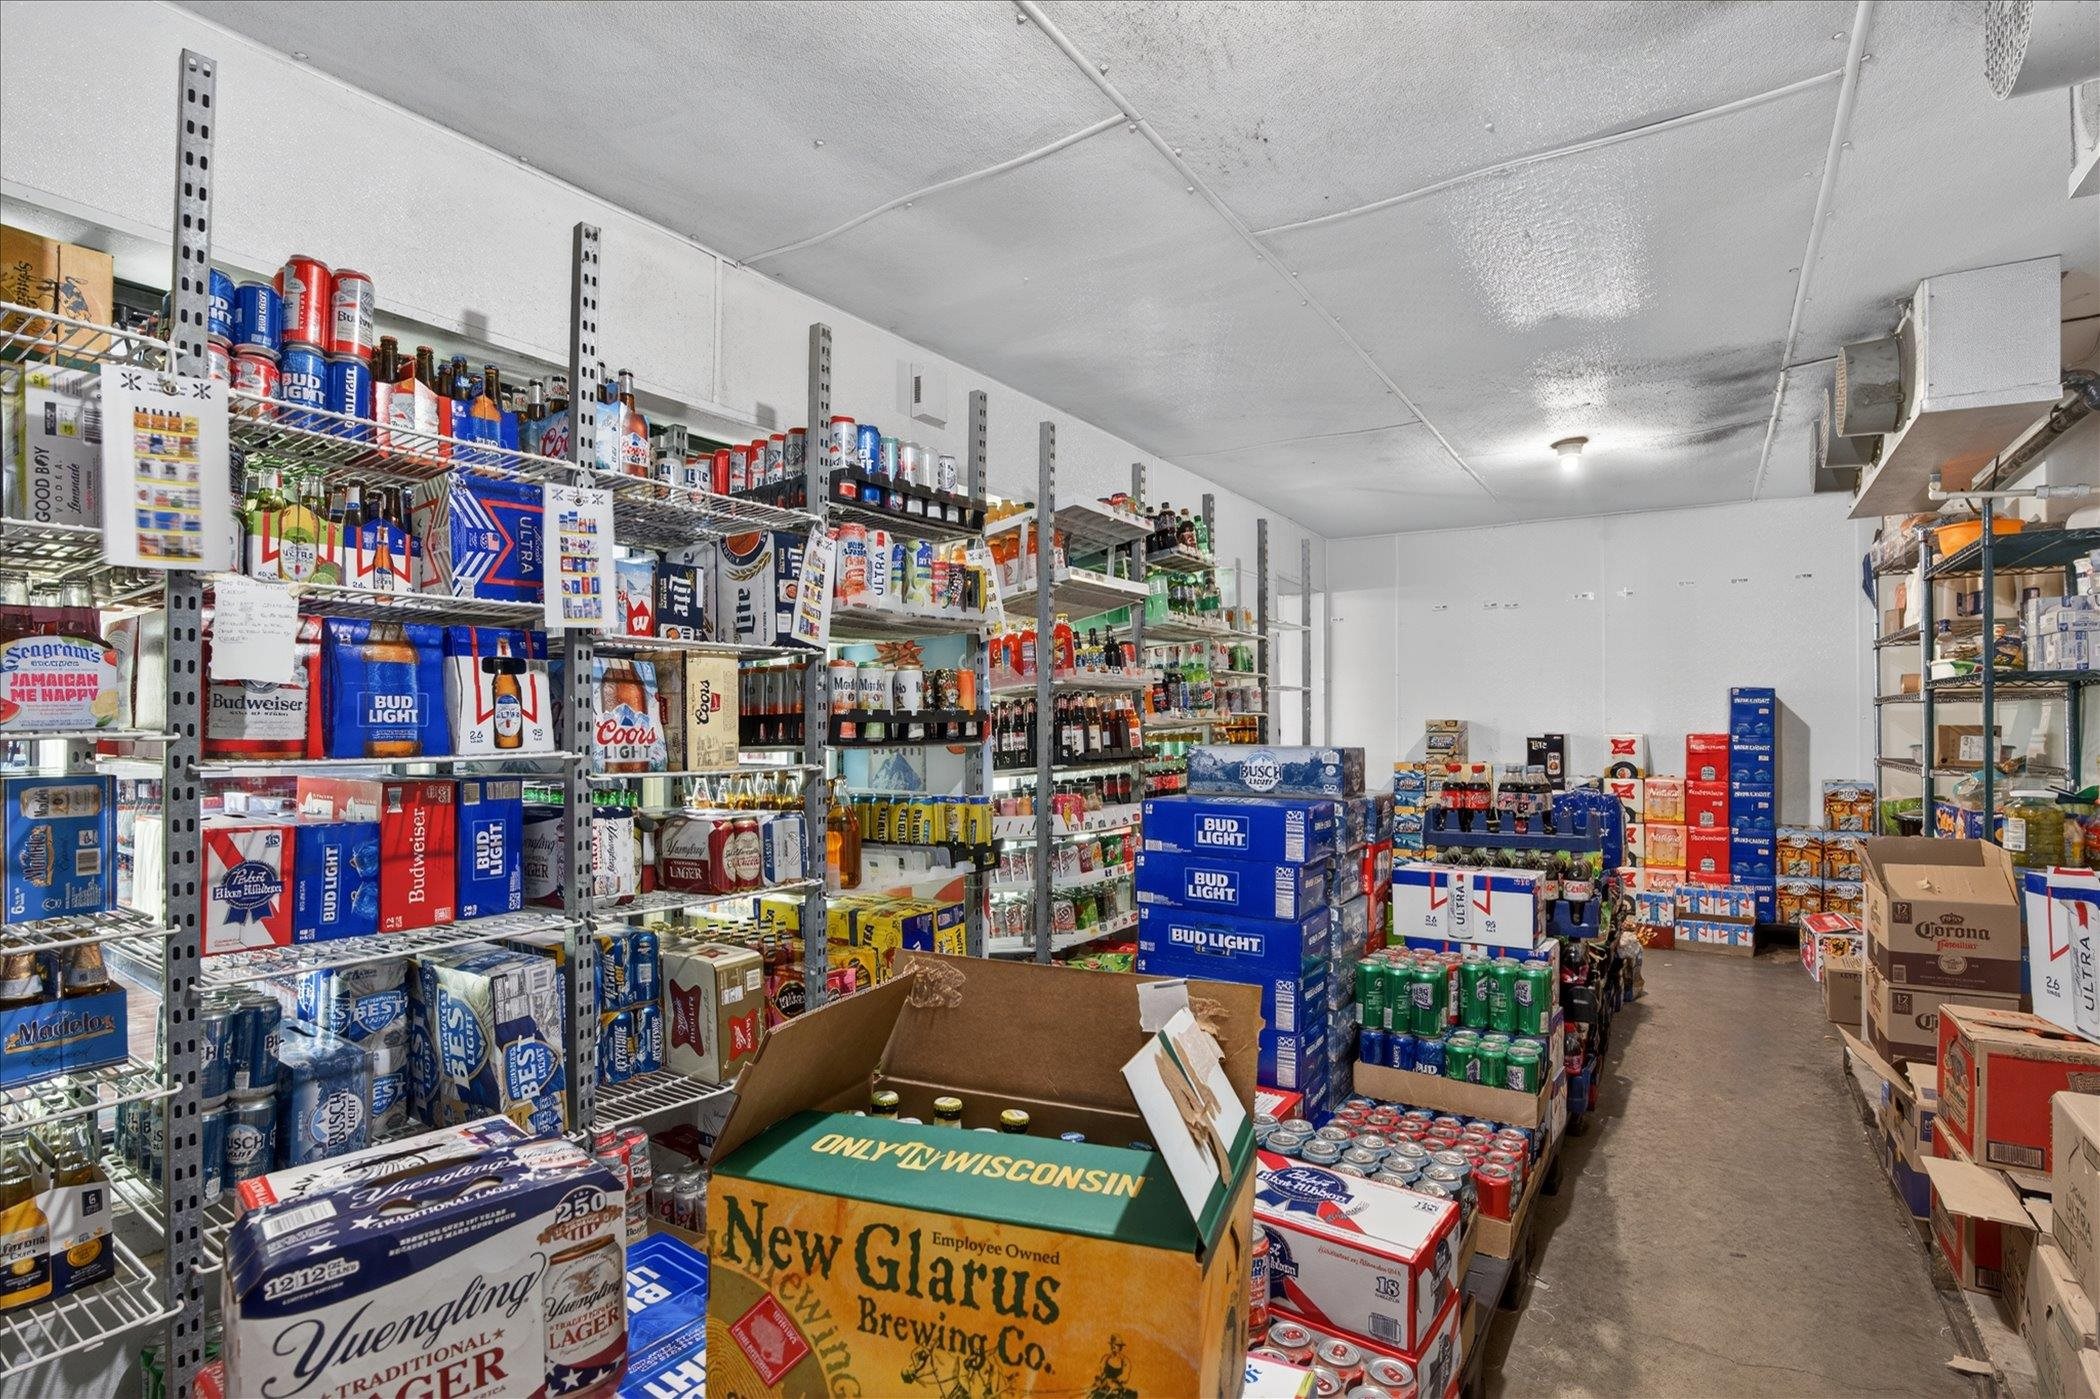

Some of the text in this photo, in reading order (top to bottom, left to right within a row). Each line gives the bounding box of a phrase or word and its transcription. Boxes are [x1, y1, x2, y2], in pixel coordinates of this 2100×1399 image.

[34, 446, 51, 523] GOOD BOY
[518, 516, 533, 575] ULTRA
[872, 550, 886, 596] ULTRA
[735, 587, 756, 634] Lite
[0, 642, 101, 674] Seagram's
[9, 673, 99, 688] JAMAICAN
[9, 688, 100, 703] ME HAPPY
[213, 693, 303, 711] Budweiser
[368, 708, 419, 724] LIGHT
[374, 695, 413, 709] BUD
[695, 679, 711, 725] Coors
[595, 719, 658, 746] Coors
[604, 745, 651, 759] LIGHT
[1240, 765, 1283, 780] BUSCH
[1197, 831, 1247, 847] LIGHT
[1204, 817, 1239, 832] BUD
[408, 806, 426, 905] Budweiser
[476, 830, 491, 870] BUD
[490, 824, 504, 876] LIGHT
[323, 846, 340, 923] BUD LIGHT
[1187, 885, 1237, 902] LIGHT
[1194, 872, 1229, 887] BUD
[1455, 885, 1466, 926] ULTRA
[1170, 928, 1262, 952] BUD LIGHT
[1914, 920, 1991, 942] Corona
[2080, 935, 2095, 1012] ULTRA
[19, 1011, 101, 1046] Modelo
[353, 998, 406, 1020] BEST
[464, 1012, 476, 1066] LIGHT
[517, 1034, 541, 1101] BEST
[327, 1088, 349, 1148] BUSCH
[350, 1156, 512, 1209] Yuengling
[810, 1133, 900, 1162] ONLY
[940, 1149, 1147, 1199] WISCONSIN
[1285, 1168, 1336, 1187] Pabst
[376, 1182, 521, 1229] TRADITIONAL LAGER
[557, 1193, 607, 1225] 250
[721, 1195, 843, 1281] New
[931, 1231, 1061, 1265] Employee Owned
[267, 1265, 326, 1298] 12 12
[854, 1222, 1061, 1325] Glarus
[1375, 1275, 1400, 1299] 18
[544, 1276, 623, 1323] Yuengling
[262, 1251, 547, 1398] Yuengling
[549, 1306, 621, 1350] LAGER
[856, 1294, 988, 1372] Brewing
[998, 1325, 1055, 1375] Co.
[335, 1331, 492, 1399] TRADITIONAL
